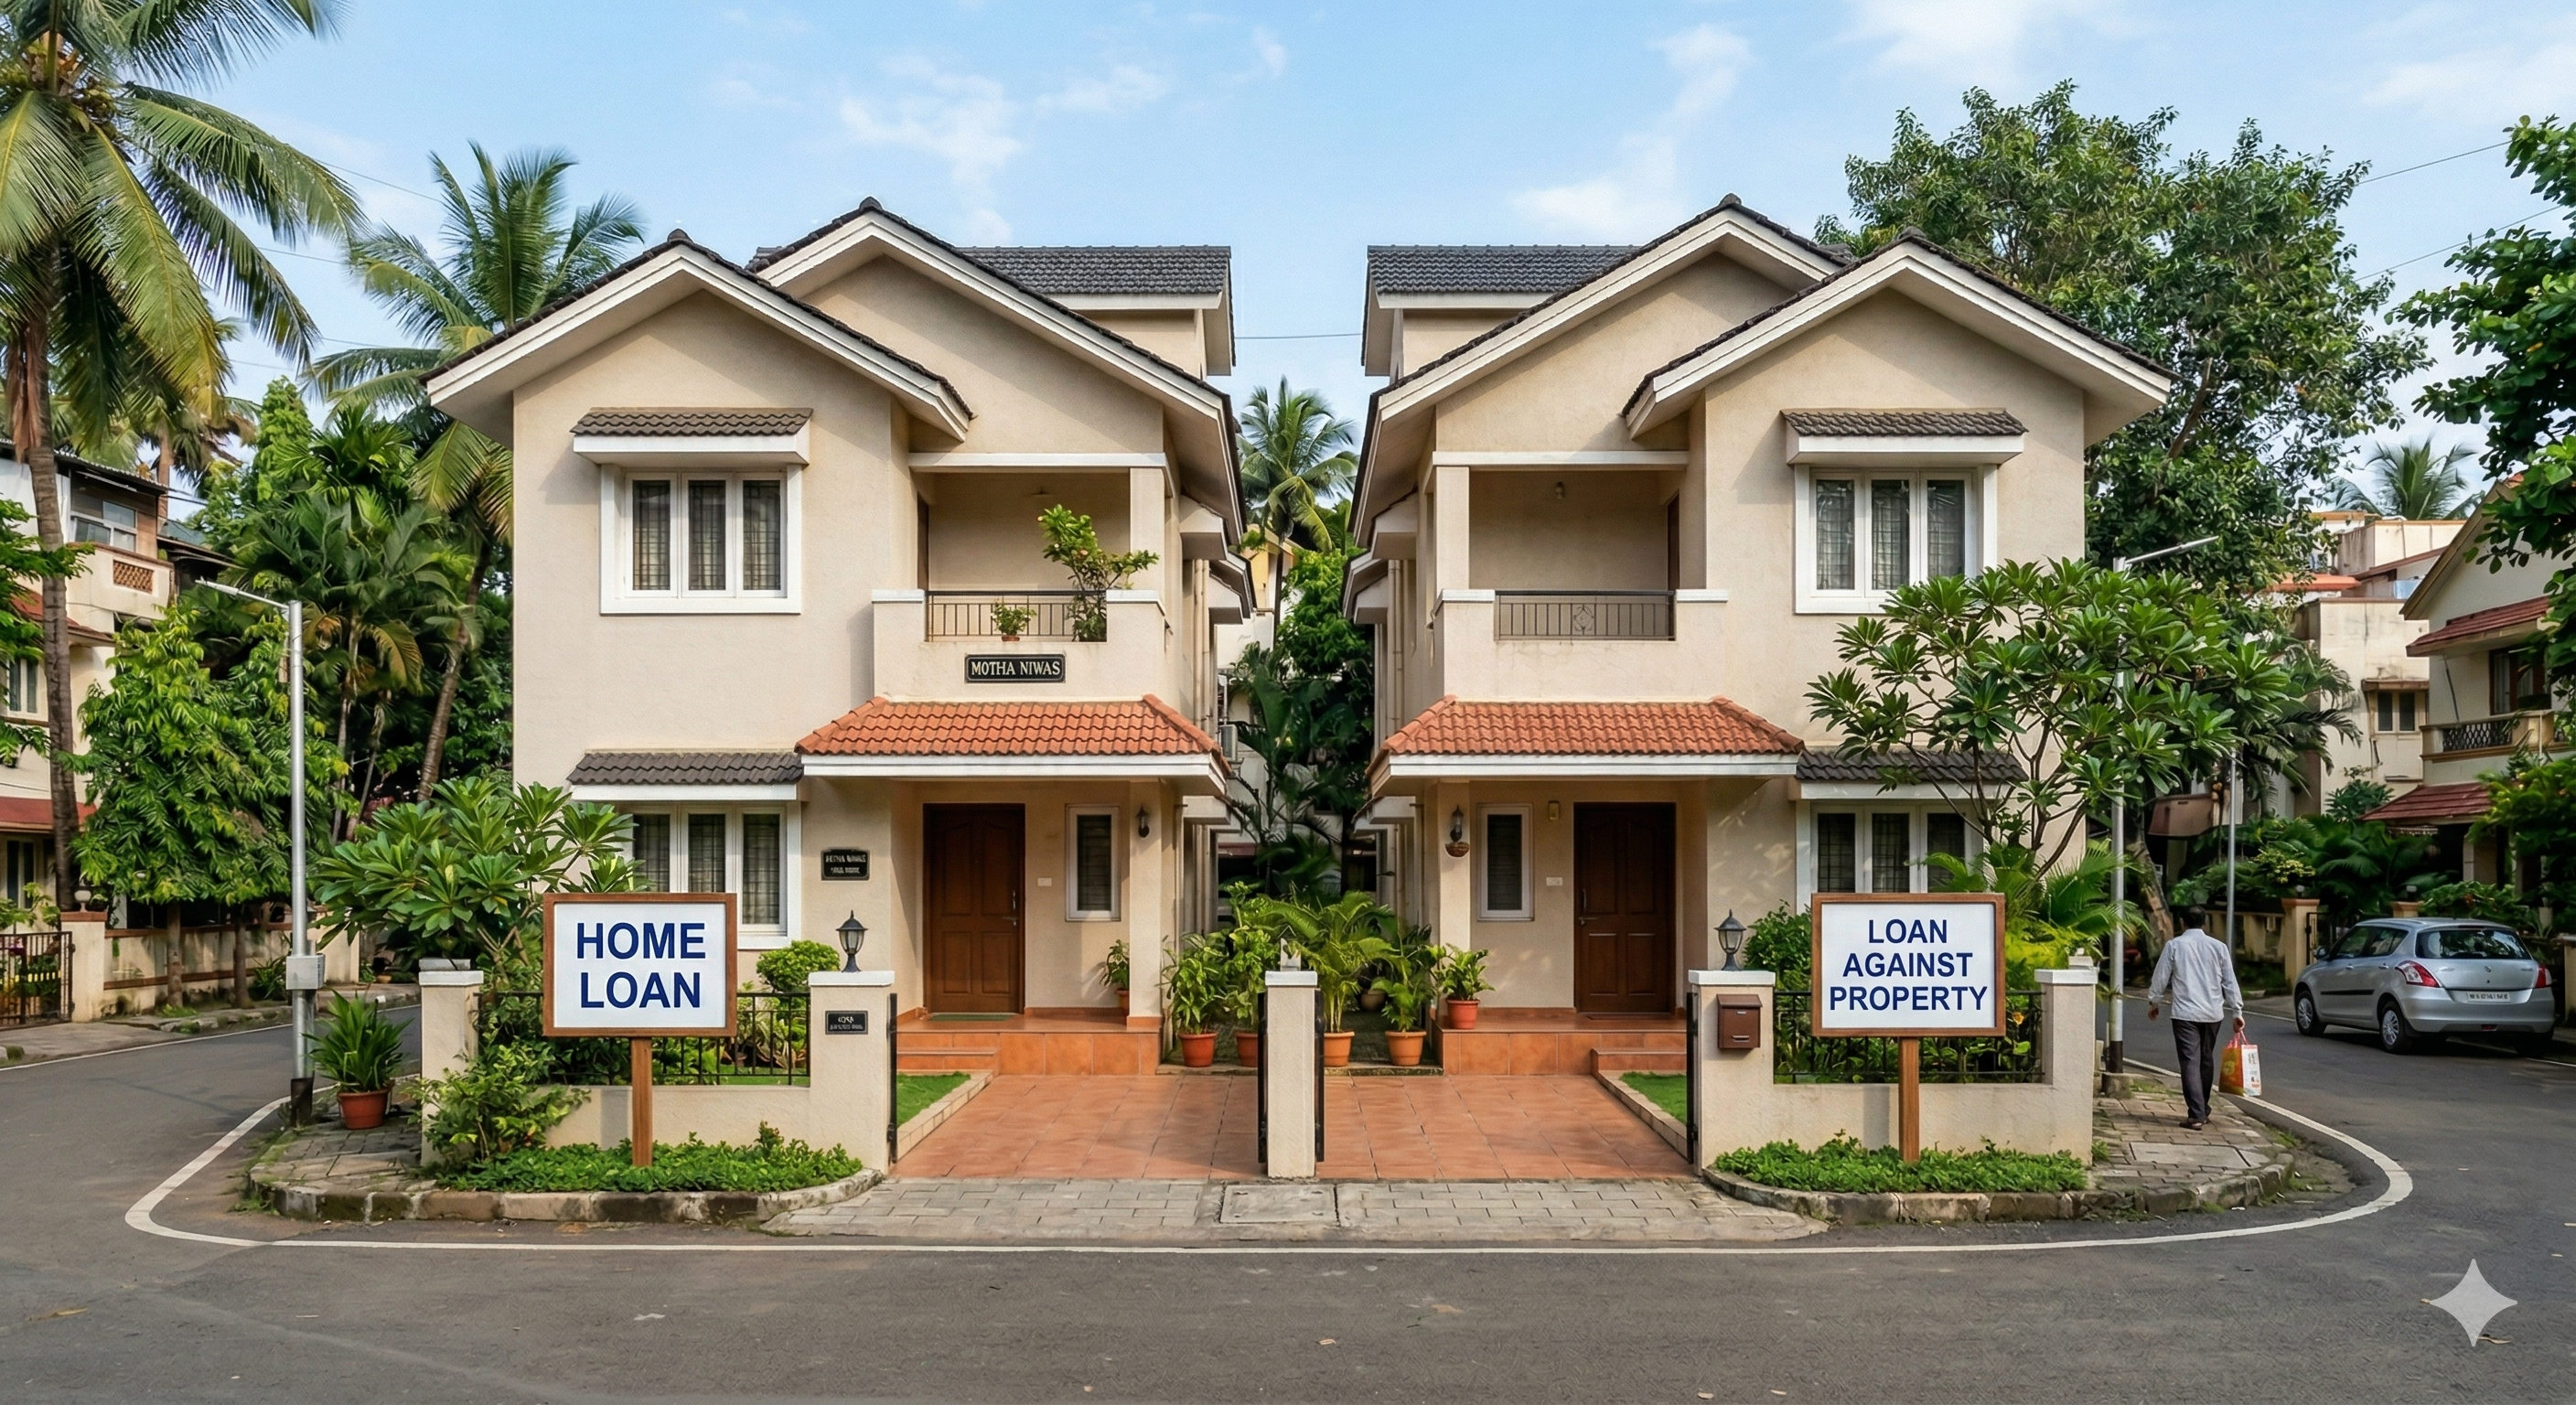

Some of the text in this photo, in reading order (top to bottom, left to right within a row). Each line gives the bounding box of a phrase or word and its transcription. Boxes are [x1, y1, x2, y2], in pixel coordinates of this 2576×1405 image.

[971, 661, 1060, 675] MOTHA NIWAS
[576, 922, 706, 960] HOME
[1868, 918, 1948, 944] LOAN
[1842, 952, 1973, 978] AGAINST
[580, 971, 701, 1009] LOAN
[1830, 986, 1988, 1011] PROPERTY
